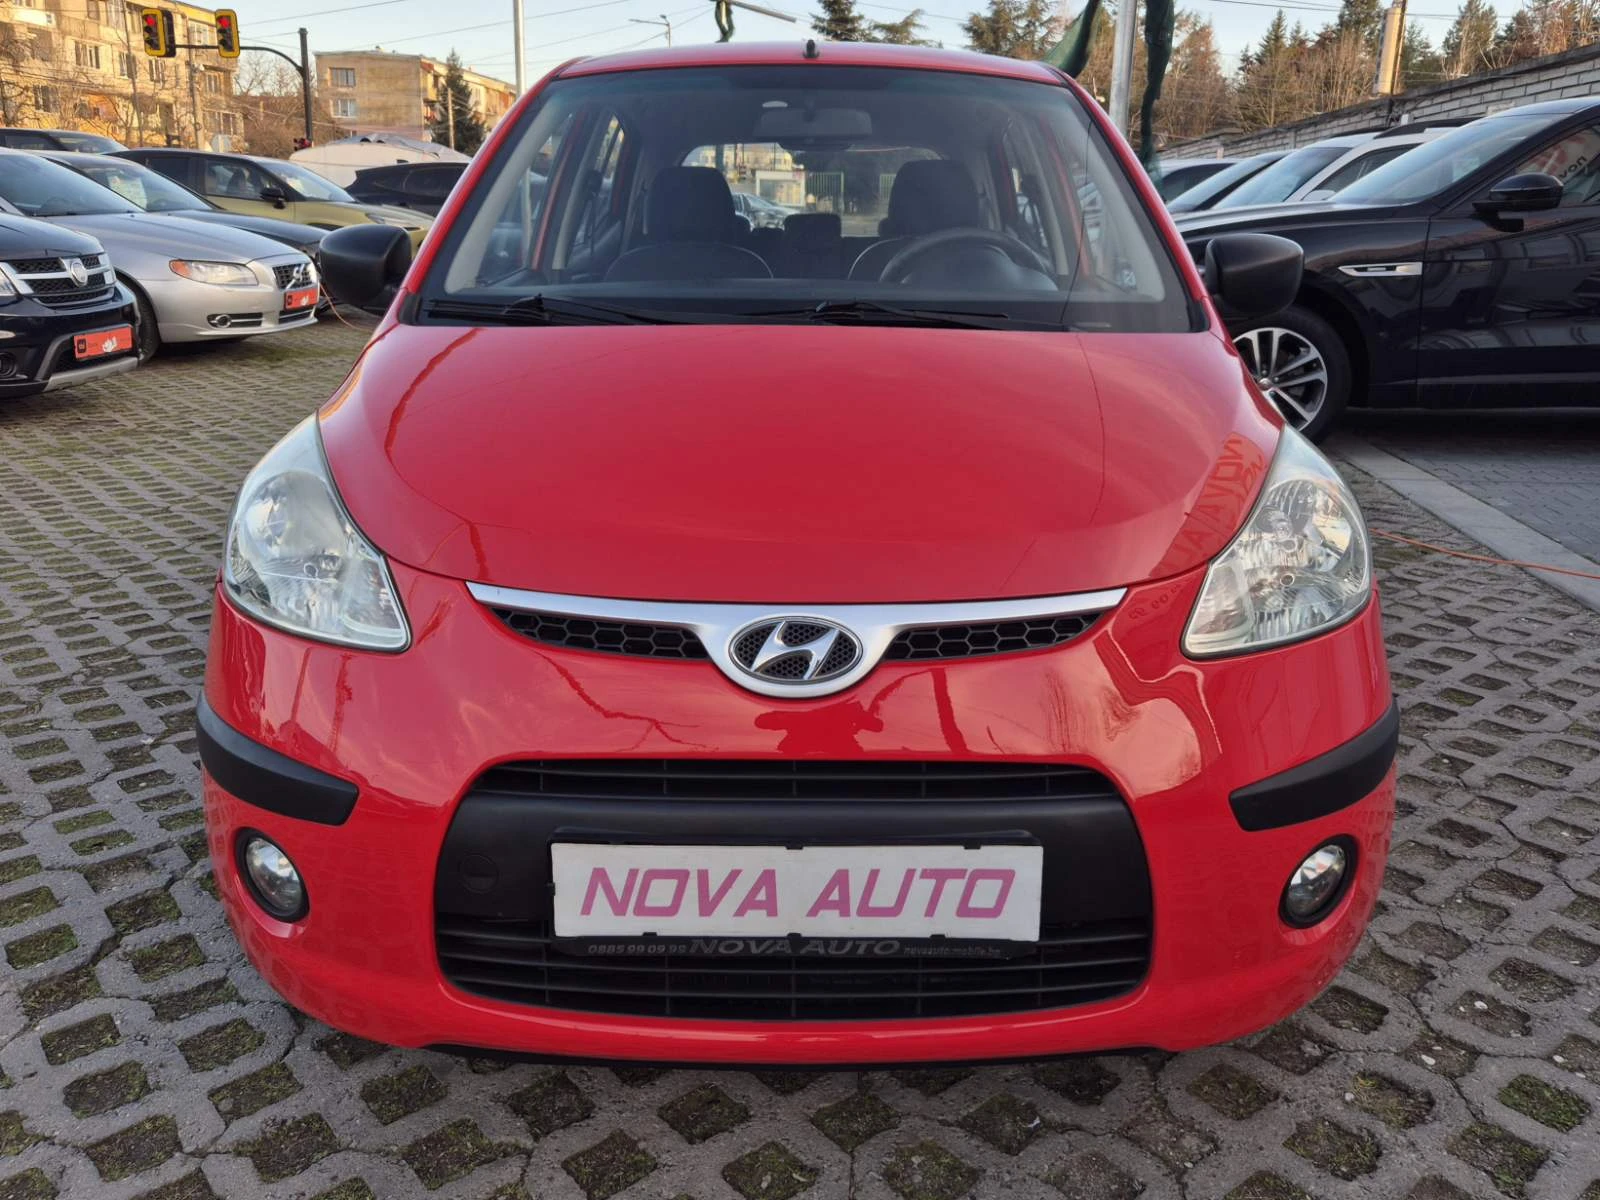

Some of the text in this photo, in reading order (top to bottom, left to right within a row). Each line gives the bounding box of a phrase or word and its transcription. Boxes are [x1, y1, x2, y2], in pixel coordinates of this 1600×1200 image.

[580, 867, 1016, 919] NOVA AUTO
[690, 939, 900, 955] NOVA AUTO
